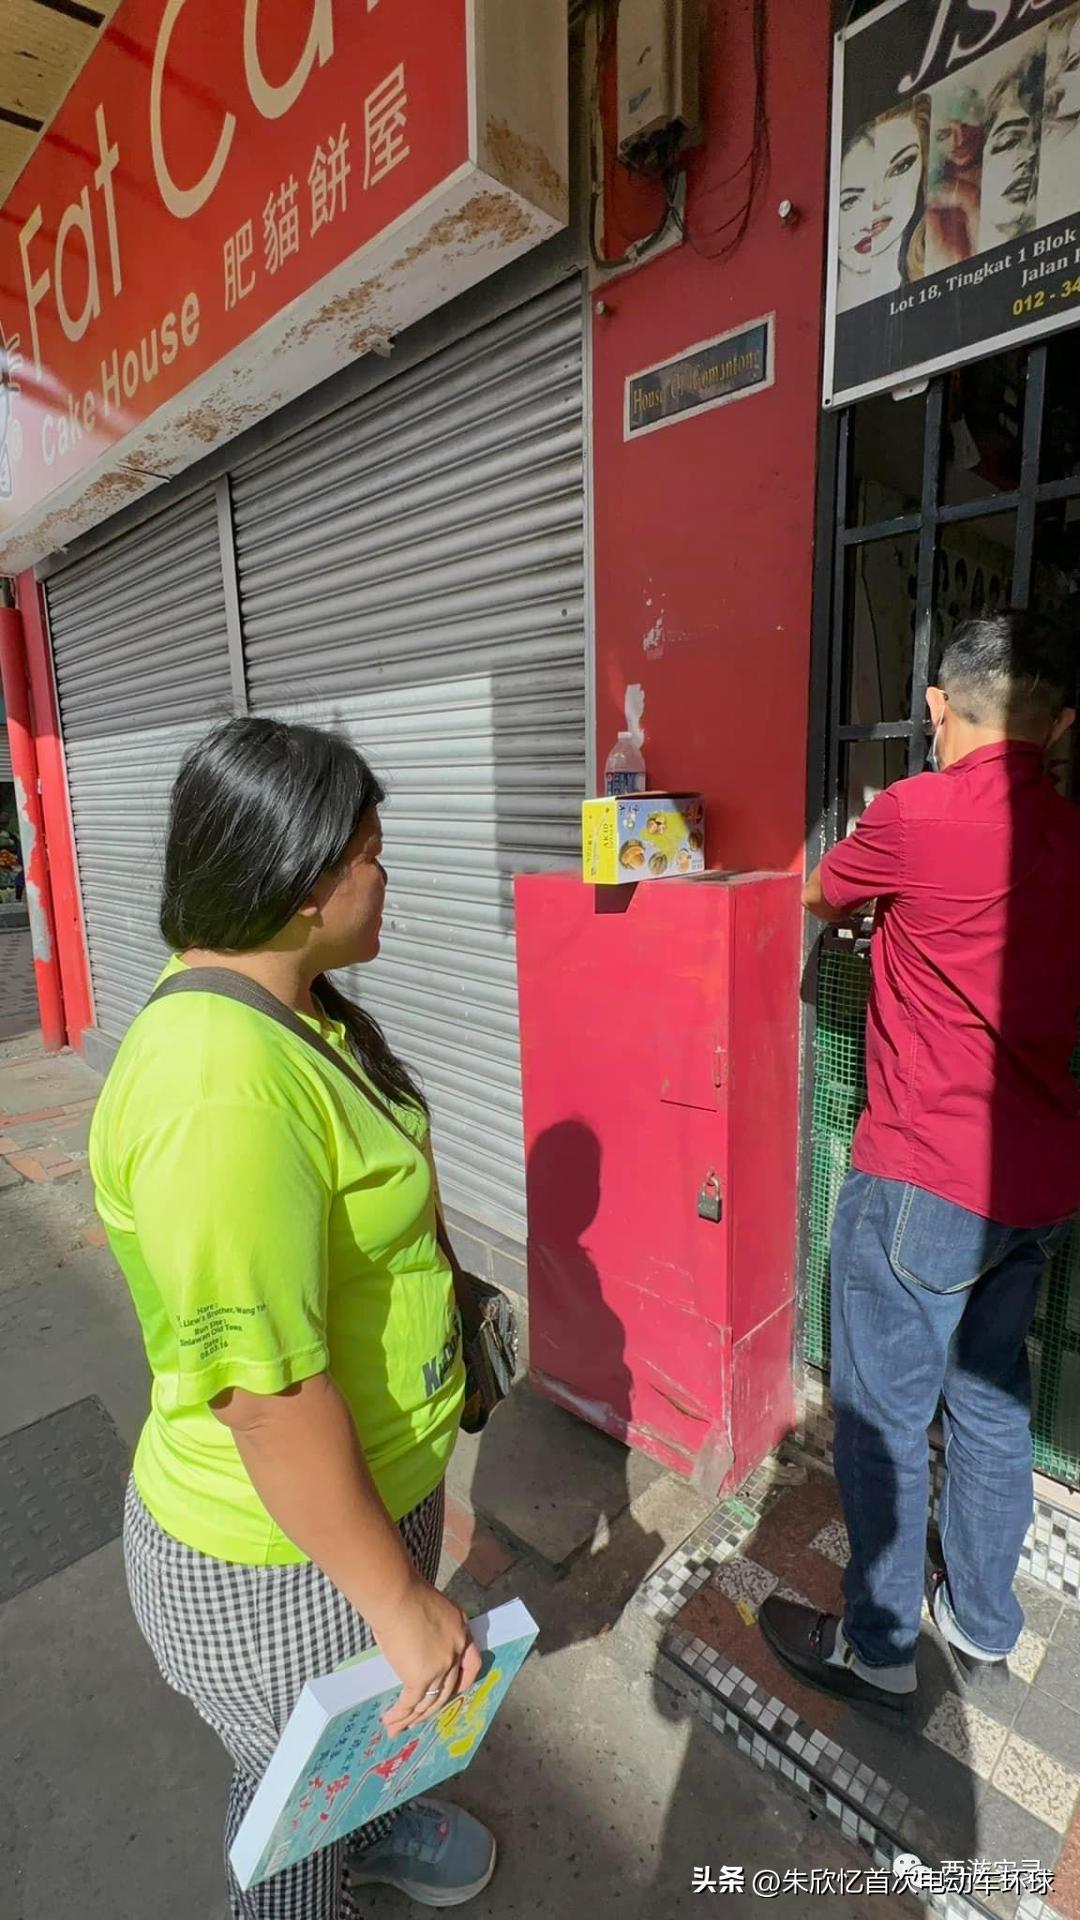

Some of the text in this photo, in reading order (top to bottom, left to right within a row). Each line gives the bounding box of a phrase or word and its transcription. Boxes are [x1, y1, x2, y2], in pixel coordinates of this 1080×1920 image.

[18, 0, 379, 382] Fat Ca
[222, 61, 411, 312] 肥貓餅屋
[889, 228, 1077, 316] Lot 18, Tingkat 1 Blok
[1012, 290, 1046, 316] 012
[1021, 256, 1068, 288] Jalan
[40, 291, 200, 465] Cake House
